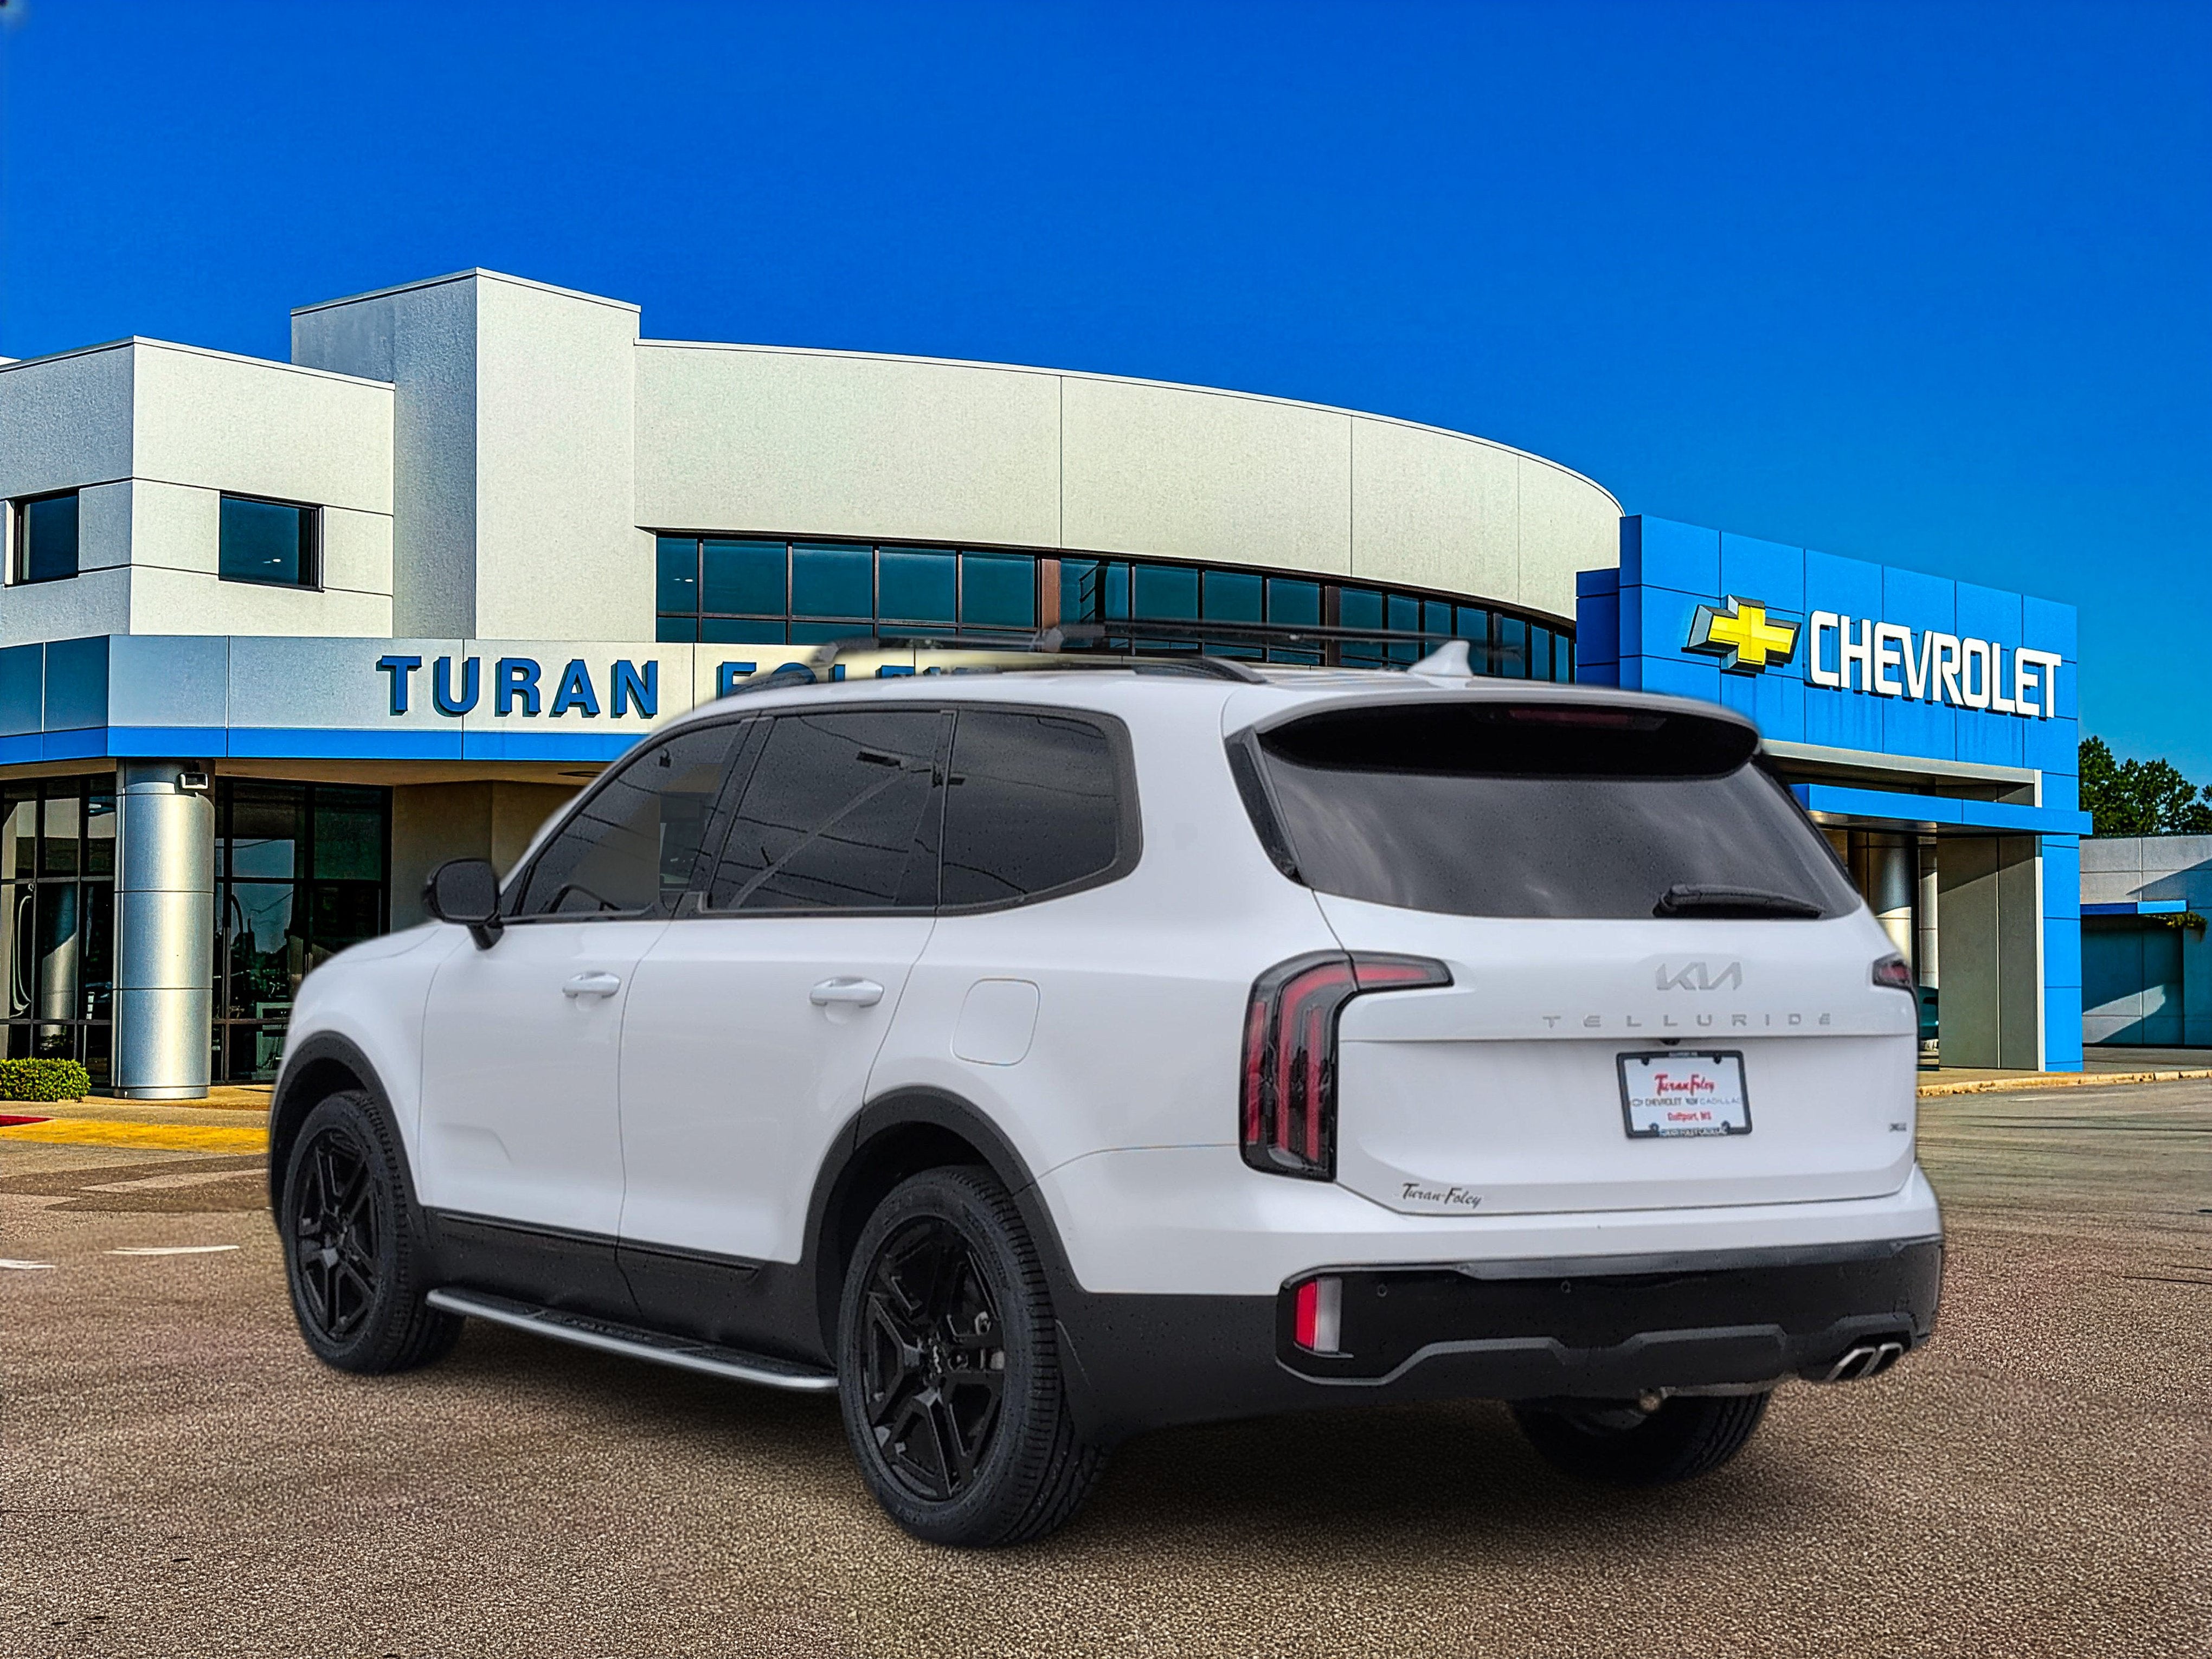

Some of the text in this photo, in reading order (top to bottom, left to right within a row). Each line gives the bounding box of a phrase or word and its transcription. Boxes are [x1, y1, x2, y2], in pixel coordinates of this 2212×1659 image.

[375, 654, 658, 718] TURAN
[1810, 610, 2062, 719] CHEVROLET
[1655, 961, 1741, 991] KIA
[1542, 1012, 1831, 1028] TELLURIDE
